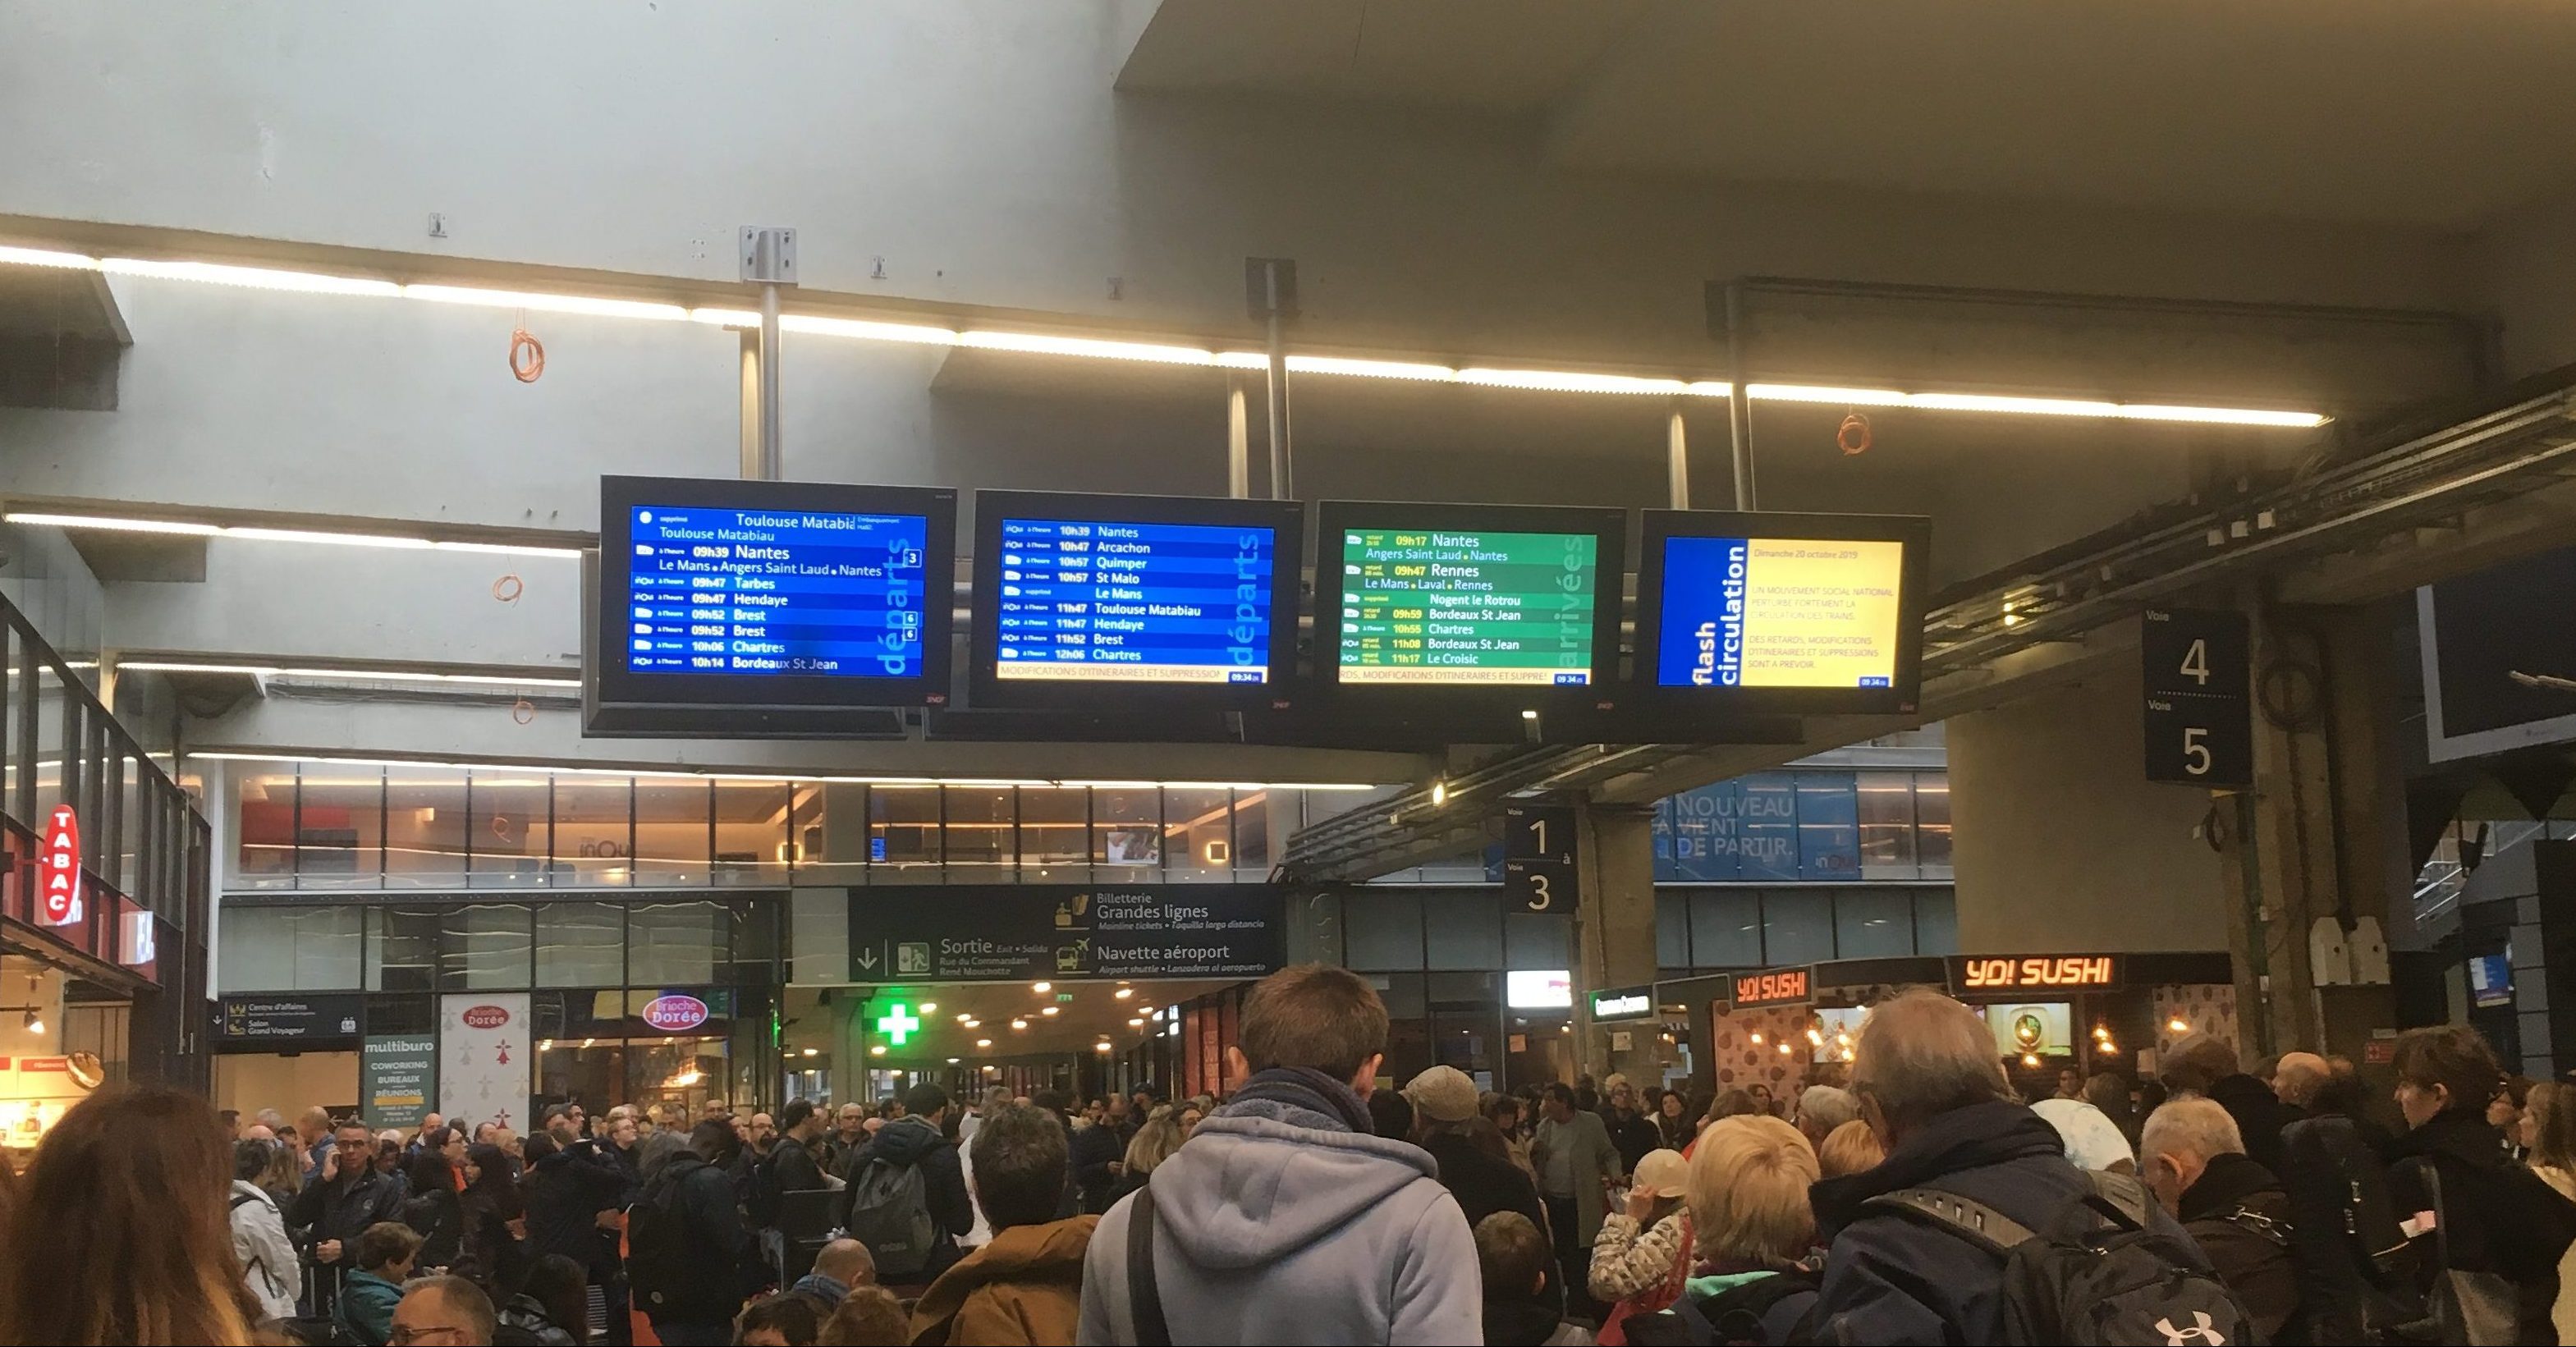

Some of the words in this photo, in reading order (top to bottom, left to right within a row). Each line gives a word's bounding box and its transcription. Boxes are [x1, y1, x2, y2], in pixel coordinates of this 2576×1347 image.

[736, 514, 799, 528] Toulouse
[660, 527, 713, 539] Toulouse
[718, 529, 774, 541] Matabiau
[1060, 525, 1090, 536] 10h39
[1098, 526, 1139, 538] Nantes
[1396, 536, 1427, 546] 09h17
[1432, 534, 1479, 547] Nantes
[693, 546, 729, 557] 09h39
[736, 545, 790, 560] Nantes
[1059, 542, 1089, 552] 10h47
[1097, 542, 1151, 554] Arcachon
[909, 553, 917, 564] 3
[1366, 548, 1403, 561] Angers
[1405, 548, 1432, 559] Saint
[1436, 550, 1461, 560] Laud
[1470, 550, 1508, 561] Nantes
[1754, 549, 1793, 558] Dimanche
[1795, 550, 1805, 558] 20
[1807, 550, 1837, 559] octobre
[659, 559, 674, 570] Le
[677, 560, 710, 571] Mans
[720, 561, 763, 574] Angers
[765, 562, 796, 574] Saint
[800, 563, 829, 575] Laud
[840, 565, 882, 577] Nantes
[1058, 557, 1089, 567] 10h57
[1096, 557, 1147, 570] Quimper
[1395, 566, 1426, 575] 09h47
[1432, 563, 1479, 577] Rennes
[692, 577, 726, 589] 09h47
[734, 577, 775, 589] Tarbes
[1058, 572, 1089, 582] 10h57
[1096, 572, 1109, 583] St
[1112, 573, 1140, 584] Malo
[1365, 579, 1377, 589] Le
[1381, 579, 1409, 589] Mans
[1419, 579, 1445, 589] Laval
[1455, 580, 1493, 590] Rennes
[1095, 588, 1110, 598] Le
[1112, 588, 1143, 600] Mans
[1853, 588, 1894, 596] NATIONAL
[692, 593, 726, 604] 09h47
[734, 593, 788, 607] Hendaye
[1226, 534, 1263, 666] départs
[1430, 593, 1469, 607] Nogent
[1473, 594, 1482, 605] le
[1484, 595, 1521, 606] Rotrou
[1554, 536, 1583, 667] arrivées
[878, 538, 910, 675] départs
[1057, 603, 1088, 613] 11h47
[1094, 603, 1146, 615] Toulouse
[1148, 604, 1201, 616] Matabiau
[691, 610, 725, 620] 09h52
[734, 609, 766, 621] Brest
[1393, 609, 1423, 619] 09h59
[1429, 608, 1478, 621] Bordeaux
[1481, 610, 1493, 621] St
[1496, 610, 1521, 621] Jean
[1717, 547, 1744, 685] circulation
[2146, 610, 2170, 621] Voie
[1057, 619, 1087, 629] 11h47
[1094, 618, 1144, 631] Hendaye
[1393, 624, 1422, 634] 10h55
[1428, 624, 1474, 635] Chartres
[691, 625, 725, 636] 09h52
[733, 625, 765, 637] Brest
[1056, 634, 1086, 644] 11h52
[1093, 634, 1124, 644] Brest
[1392, 639, 1421, 648] 11h08
[1428, 639, 1478, 649] Bordeaux
[1480, 639, 1492, 649] St
[1494, 639, 1519, 650] Jean
[692, 642, 724, 652] 10h06
[732, 640, 785, 653] Chartres
[1055, 649, 1085, 659] 12h06
[1093, 649, 1141, 660] Chartres
[1392, 654, 1420, 663] 11h17
[1428, 653, 1437, 663] Le
[1442, 653, 1478, 664] Croisic
[1692, 621, 1717, 686] flash
[691, 657, 724, 667] 10h14
[732, 657, 790, 669] Bordeaux
[793, 658, 806, 669] St
[809, 659, 838, 670] Jean
[2180, 639, 2210, 685] 4
[1001, 666, 1076, 676] MODIFICATIONS
[1147, 669, 1157, 677] ET
[1363, 671, 1433, 680] MODIFICATIONS
[1499, 671, 1510, 680] ET
[2147, 699, 2171, 711] Voie
[2184, 727, 2211, 775] 5
[1507, 808, 1524, 816] Voie
[1676, 796, 1794, 818] NOUVEAU
[1676, 818, 1737, 836] VIENT
[1529, 819, 1545, 854] 1
[1676, 837, 1707, 857] DE
[1714, 837, 1794, 856] PARTIR.
[49, 812, 72, 910] TABAC
[1563, 852, 1571, 864] à
[1097, 892, 1152, 904] Billetterie
[1528, 874, 1550, 910] 3
[1098, 905, 1161, 919] Grandes
[1164, 904, 1208, 921] lignes
[1135, 921, 1163, 930] tickets
[1227, 920, 1265, 929] distancia
[941, 937, 992, 955] Sortie
[1022, 944, 1048, 953] Salida
[1098, 946, 1160, 960] Navette
[1163, 945, 1231, 962] aéroport
[939, 957, 956, 965] Rue
[959, 957, 970, 965] du
[971, 957, 1030, 965] Commandant
[939, 968, 961, 976] René
[963, 967, 1011, 976] Mouchotte
[1098, 965, 1128, 975] Airport
[1221, 963, 1266, 974] aeropuerto
[1966, 959, 2016, 986] YO!
[2020, 957, 2111, 985] SUSHI
[1737, 978, 1760, 1003] YO!
[1762, 972, 1806, 1000] SUSHI
[248, 1003, 273, 1011] Centre
[657, 1001, 697, 1012] Brioche
[468, 1015, 505, 1026] Dorée
[652, 1010, 701, 1024] Dorée
[247, 1027, 270, 1035] Grand
[271, 1027, 305, 1036] Voyageur
[364, 1040, 434, 1053] multiburo
[370, 1061, 428, 1070] COWORKING
[378, 1075, 420, 1084] BUREAUX
